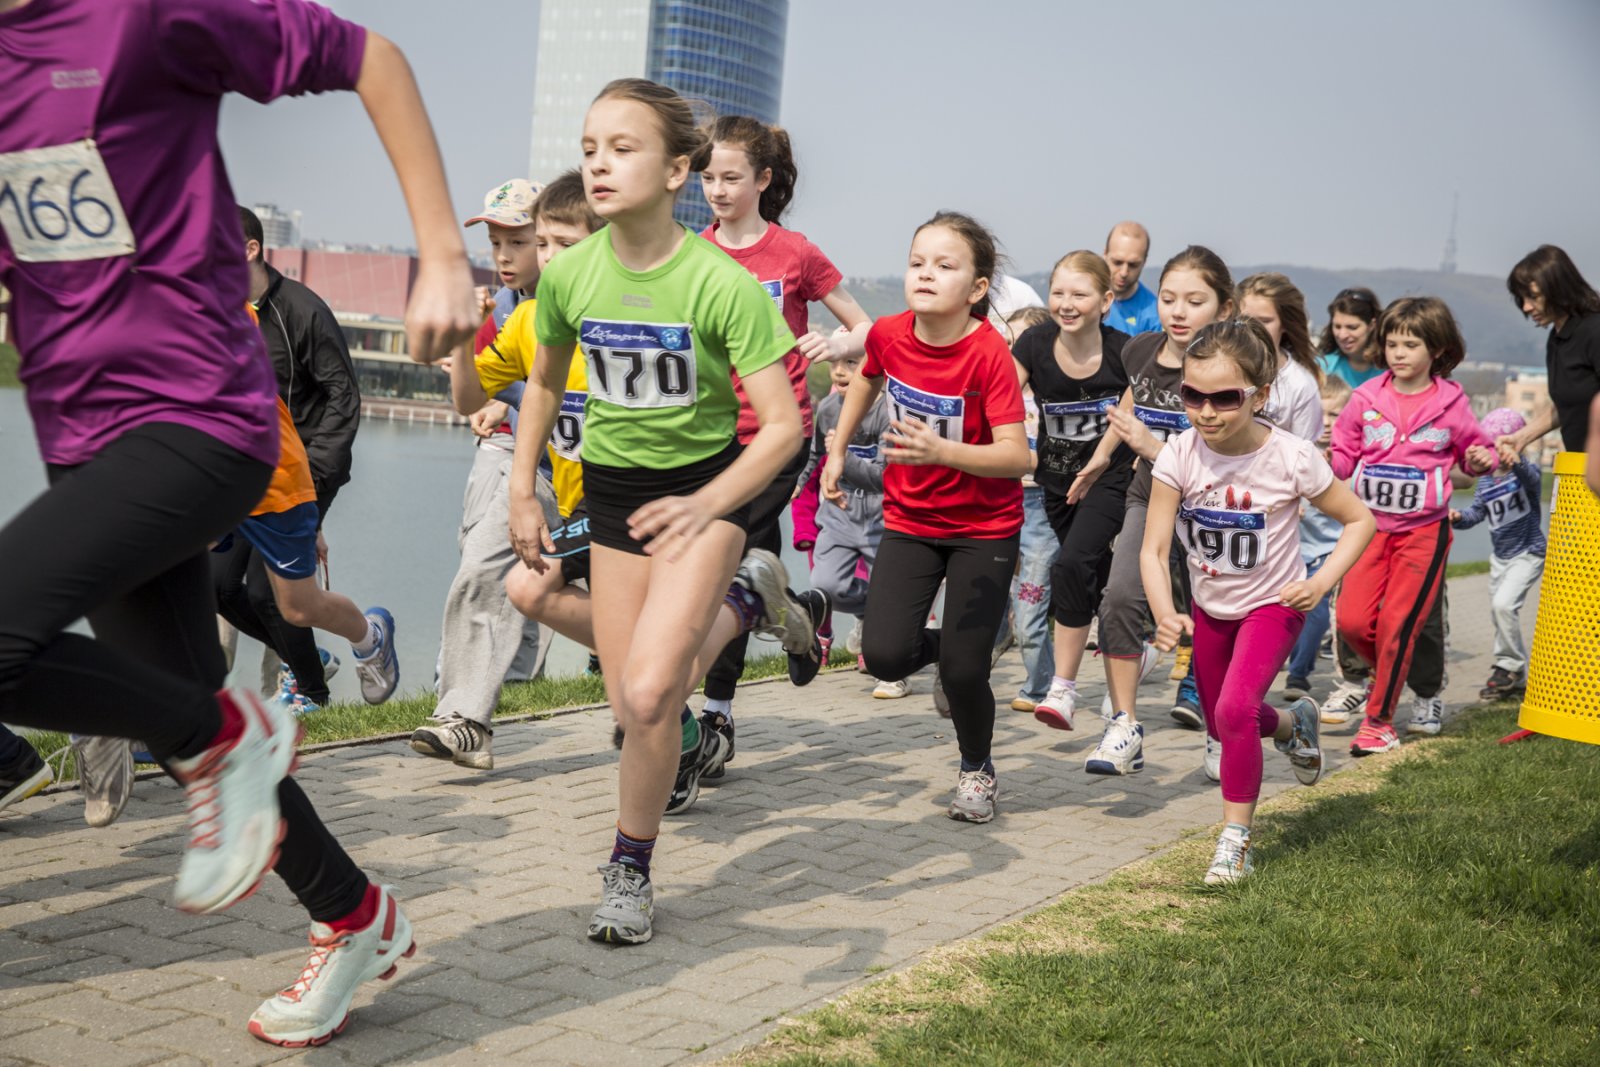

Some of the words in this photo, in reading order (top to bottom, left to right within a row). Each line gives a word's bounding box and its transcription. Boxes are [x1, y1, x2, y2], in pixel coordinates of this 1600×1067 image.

[0, 168, 114, 241] 166
[587, 346, 690, 399] 170
[1362, 478, 1419, 509] 188
[1181, 519, 1260, 570] 190
